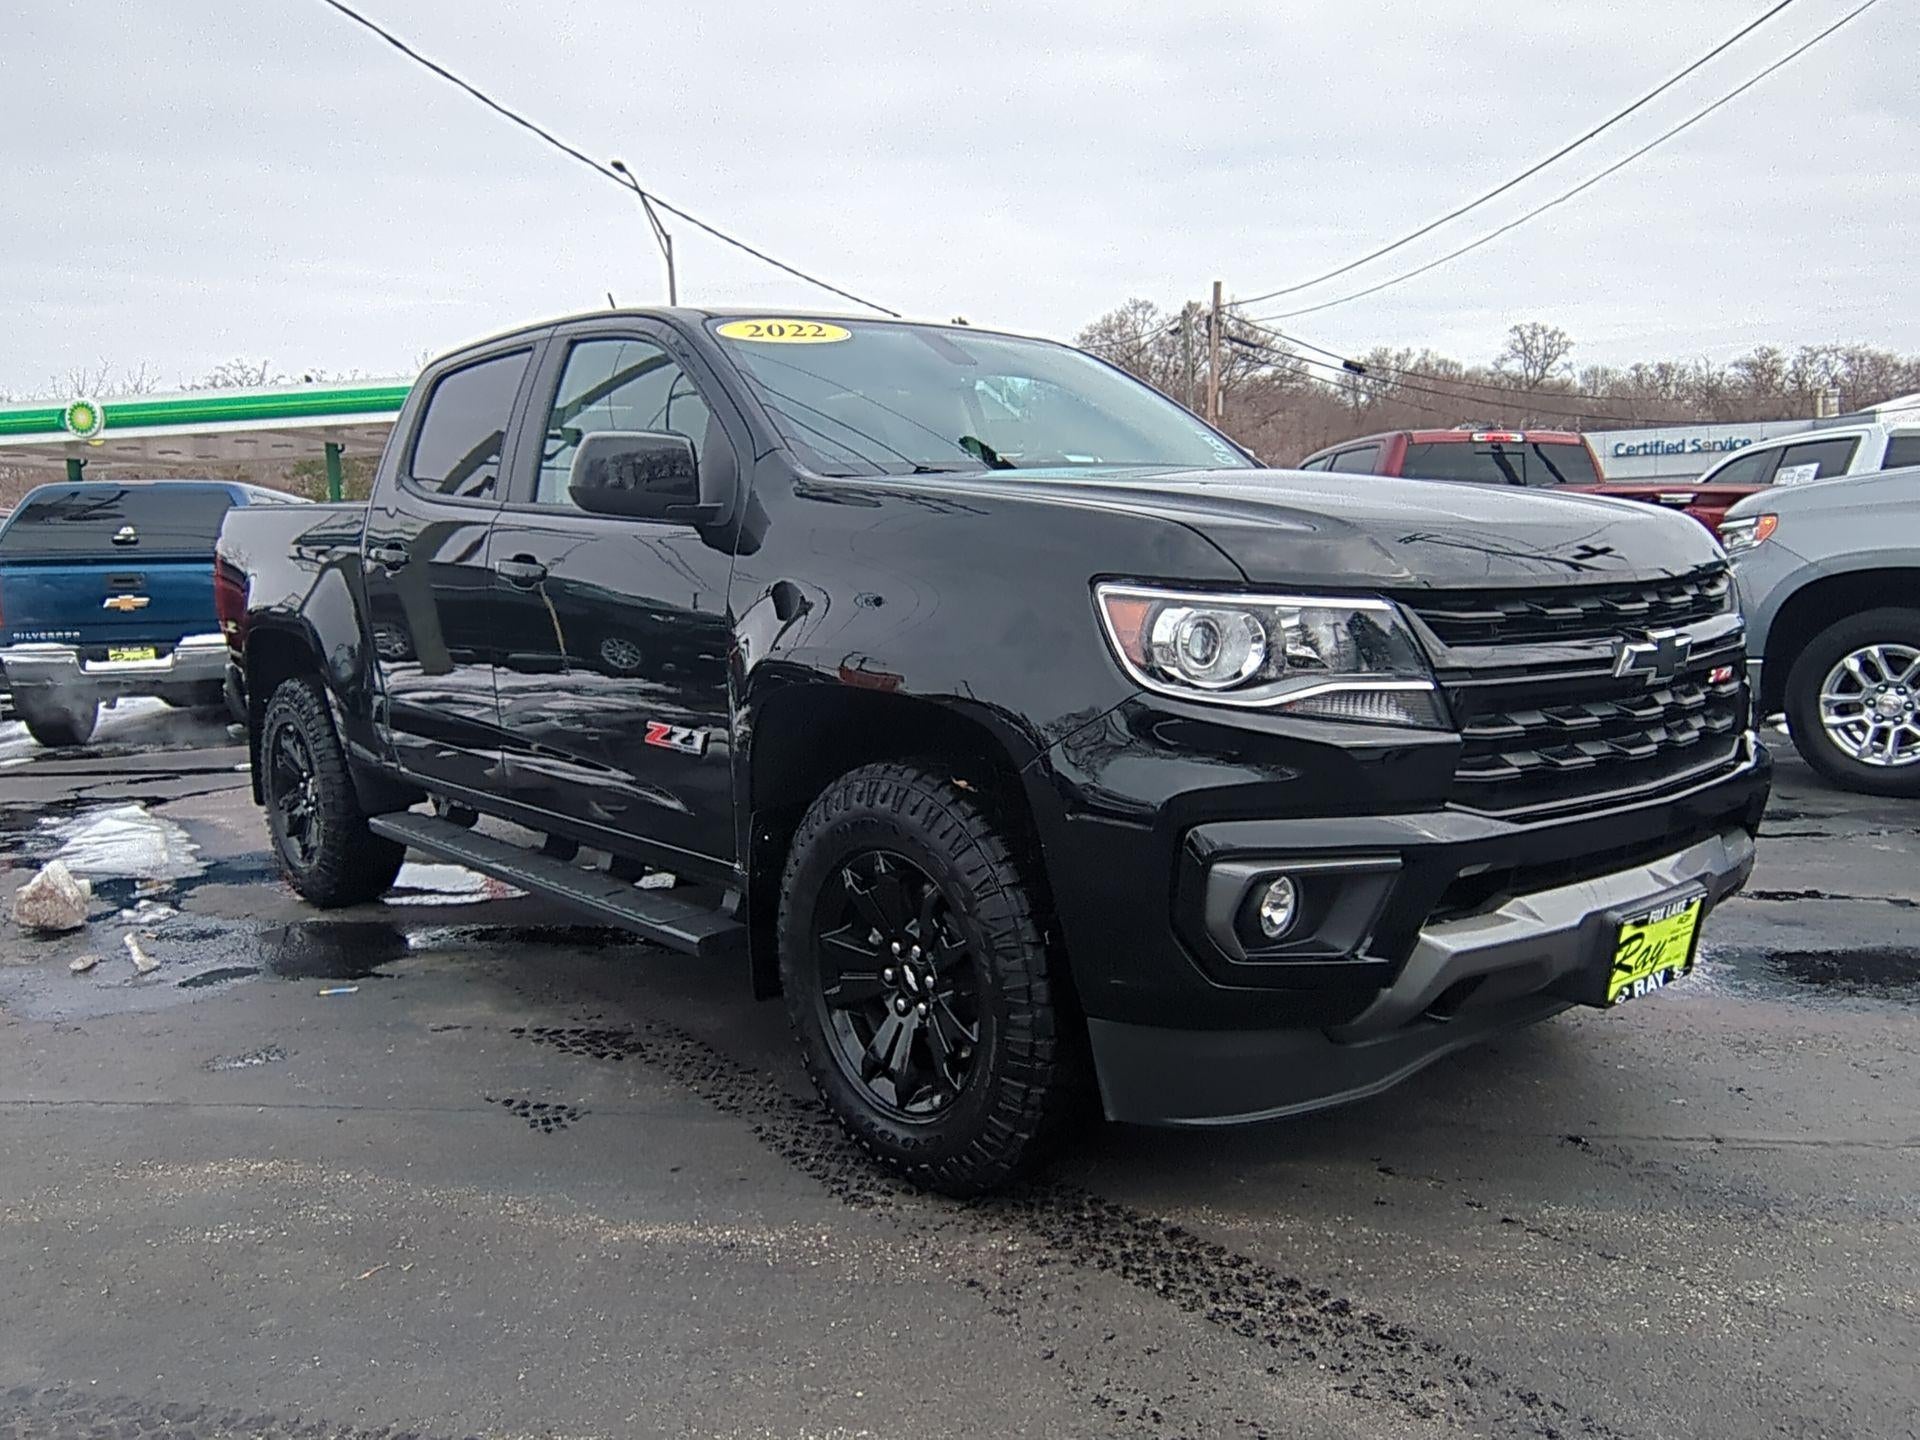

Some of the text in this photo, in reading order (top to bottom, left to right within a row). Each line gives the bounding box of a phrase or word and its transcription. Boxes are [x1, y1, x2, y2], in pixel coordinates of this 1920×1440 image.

[744, 324, 827, 338] 2022
[1613, 436, 1752, 457] Certified Service
[645, 721, 708, 755] Z71
[1648, 907, 1666, 925] FOX
[1613, 932, 1668, 974] Ray
[1633, 970, 1665, 998] RAY
